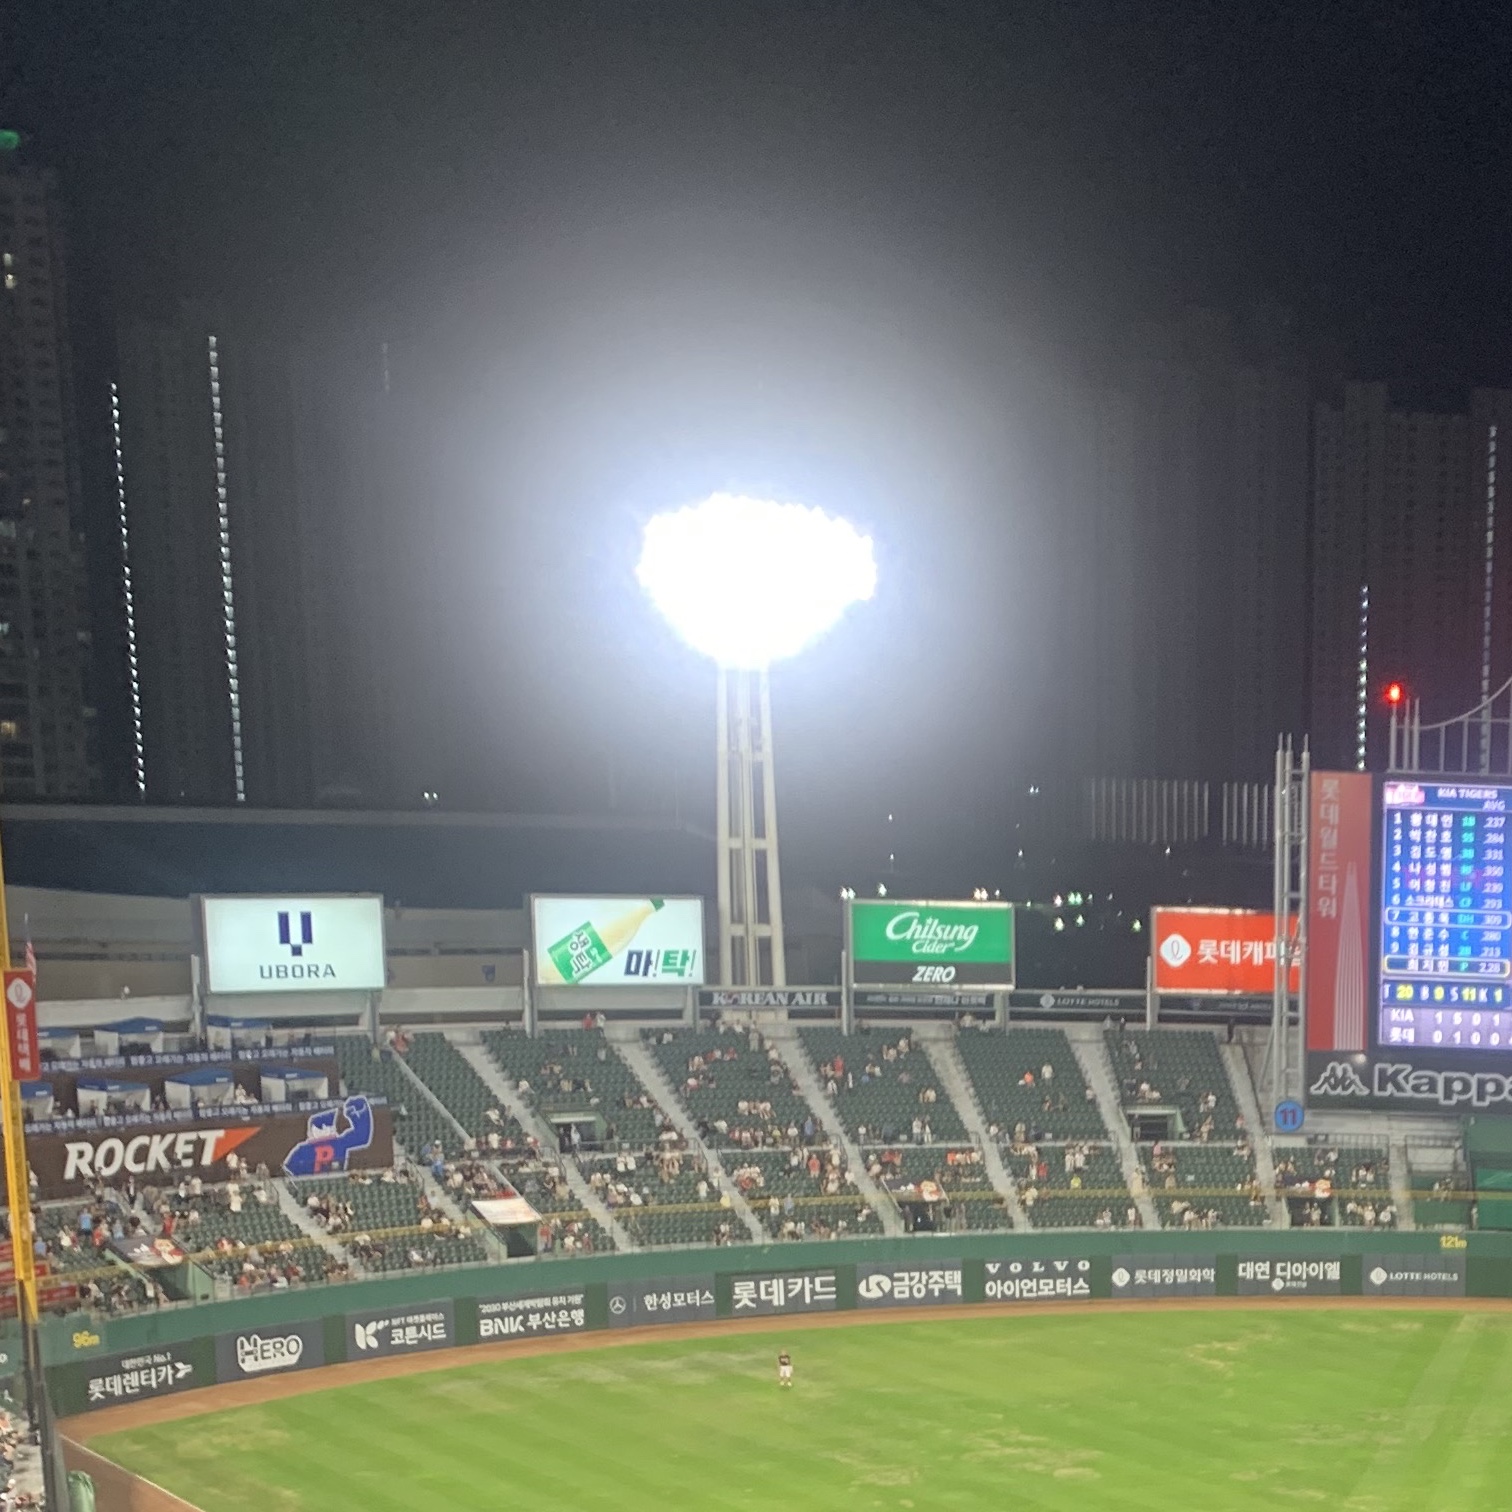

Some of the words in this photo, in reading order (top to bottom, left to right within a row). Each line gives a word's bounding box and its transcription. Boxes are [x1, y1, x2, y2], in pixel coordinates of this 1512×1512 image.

[1318, 779, 1340, 918] 롯데월드타워
[885, 911, 979, 950] Chilsung
[911, 939, 957, 954] Cider
[259, 964, 337, 980] UBORA
[911, 964, 956, 984] ZERO
[712, 991, 789, 1005] KOREAN
[791, 991, 828, 1005] AIR
[1391, 1009, 1414, 1022] KIA
[1279, 1107, 1297, 1126] 11
[63, 1129, 227, 1181] ROCKET
[985, 1259, 1090, 1273] VOLVO
[1134, 1267, 1215, 1284] 롯데정밀화학
[1238, 1261, 1270, 1280] 대연
[1276, 1261, 1340, 1280] 디아이엘
[893, 1271, 962, 1298] 금강주택
[1389, 1271, 1420, 1282] LOTTE
[1423, 1271, 1458, 1282] HOTELS
[732, 1276, 838, 1309] 롯데카드
[985, 1278, 1090, 1298] 아이언모터스
[644, 1289, 715, 1312] 한성모터스
[480, 1315, 525, 1336] BNK
[526, 1309, 585, 1330] 부산은행
[73, 1332, 99, 1348] 96m
[238, 1336, 301, 1366] HERO
[88, 1364, 175, 1401] 롯데렌터카
